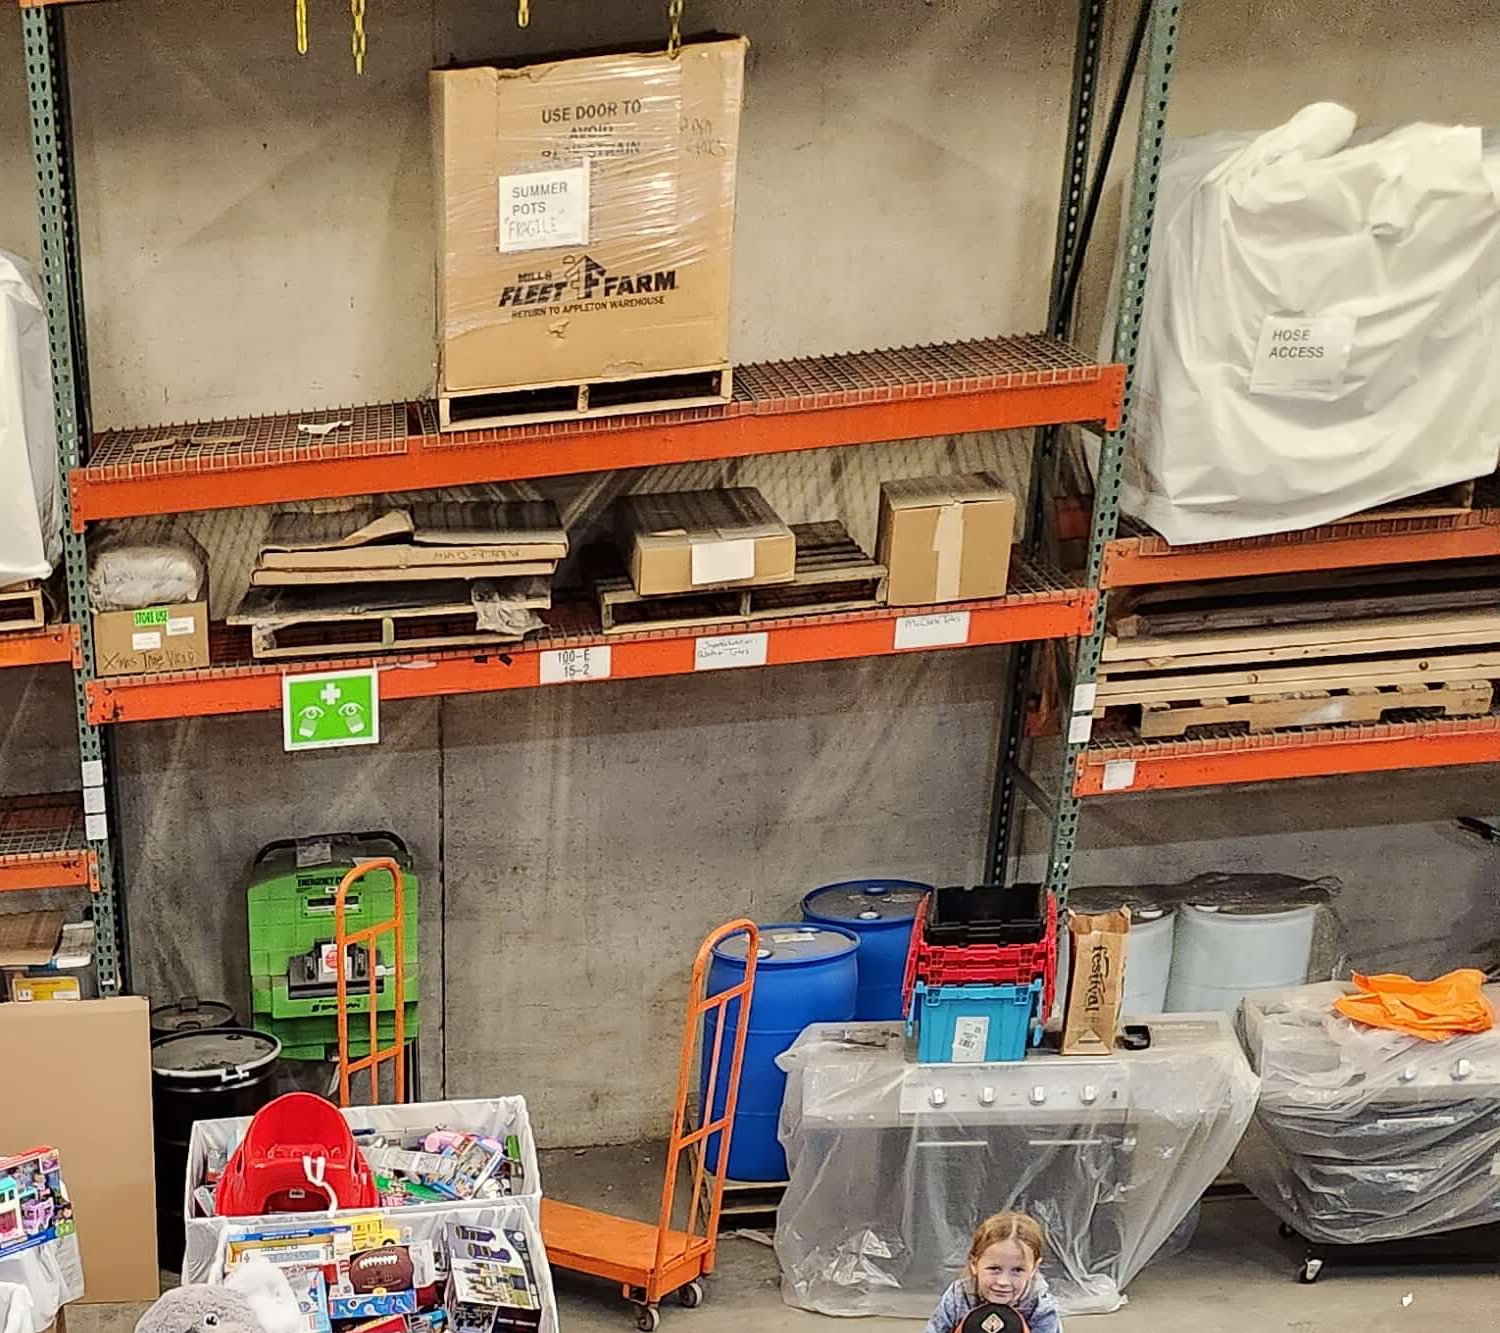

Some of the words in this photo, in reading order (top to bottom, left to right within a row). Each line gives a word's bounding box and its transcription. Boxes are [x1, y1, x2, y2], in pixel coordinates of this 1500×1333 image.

[541, 107, 571, 123] USE
[575, 102, 617, 120] DOOR
[623, 99, 642, 115] TO
[512, 181, 568, 198] SUMMER
[512, 202, 546, 216] POTS
[499, 281, 569, 307] FLEET
[603, 270, 677, 296] FARM
[562, 300, 607, 314] APPLETON
[609, 295, 665, 309] WAREHOUSE
[1272, 328, 1310, 341] HOSE
[1268, 346, 1325, 359] ACCESS
[135, 611, 154, 625] STORE
[558, 649, 590, 663] 100-E
[564, 663, 589, 677] 15-2
